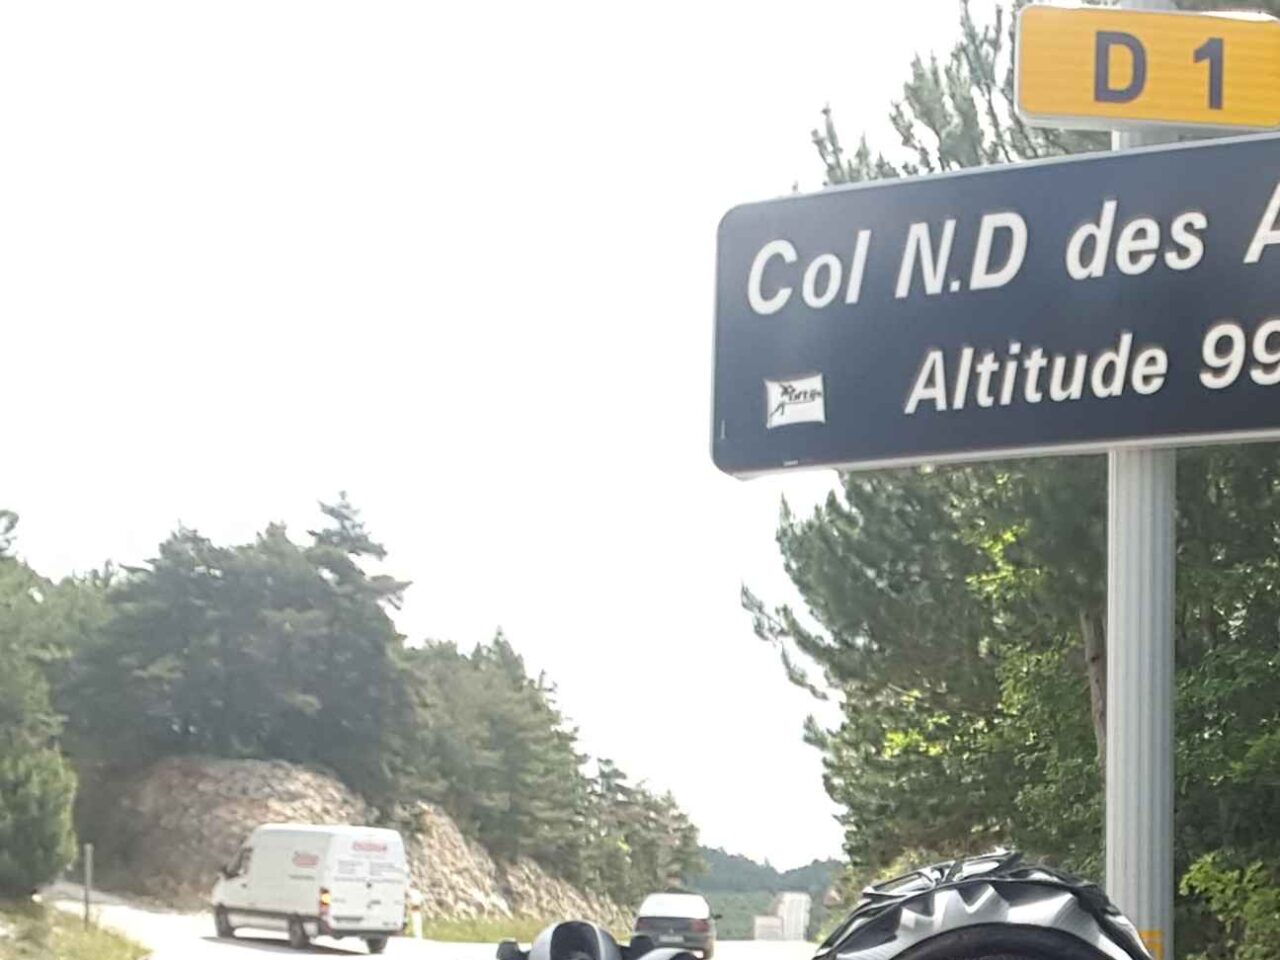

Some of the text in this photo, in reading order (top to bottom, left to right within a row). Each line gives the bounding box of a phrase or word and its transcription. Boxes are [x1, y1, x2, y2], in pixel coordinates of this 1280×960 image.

[1093, 31, 1224, 110] D 1
[747, 229, 872, 315] Col
[895, 211, 1028, 299] N.D
[1065, 200, 1208, 281] des
[904, 332, 1169, 414] Altitude
